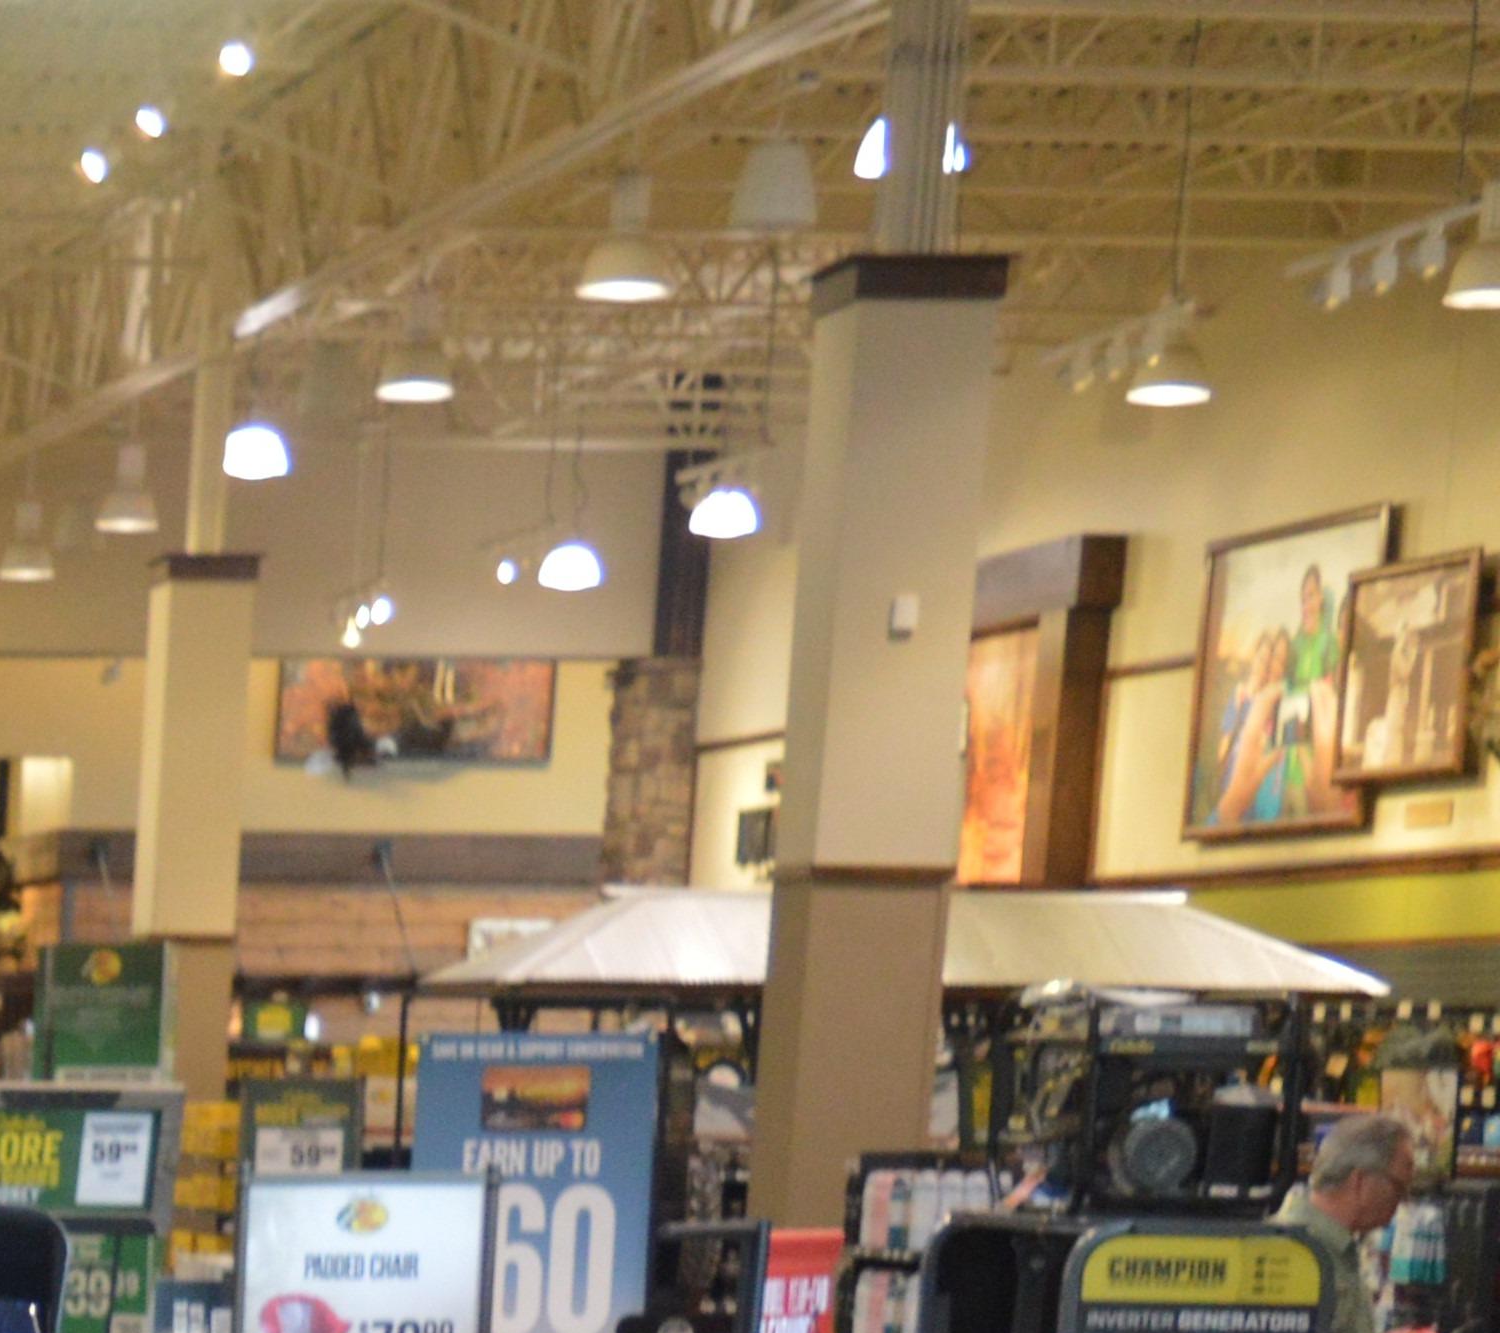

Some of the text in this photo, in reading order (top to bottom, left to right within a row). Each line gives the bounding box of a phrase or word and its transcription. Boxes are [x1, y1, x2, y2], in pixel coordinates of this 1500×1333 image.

[462, 1139, 600, 1178] EARN UP TO
[304, 1253, 420, 1280] PADDED CHAIR
[1108, 1257, 1228, 1283] CHAMPION
[1086, 1308, 1311, 1333] INVERTER GENERATORS
